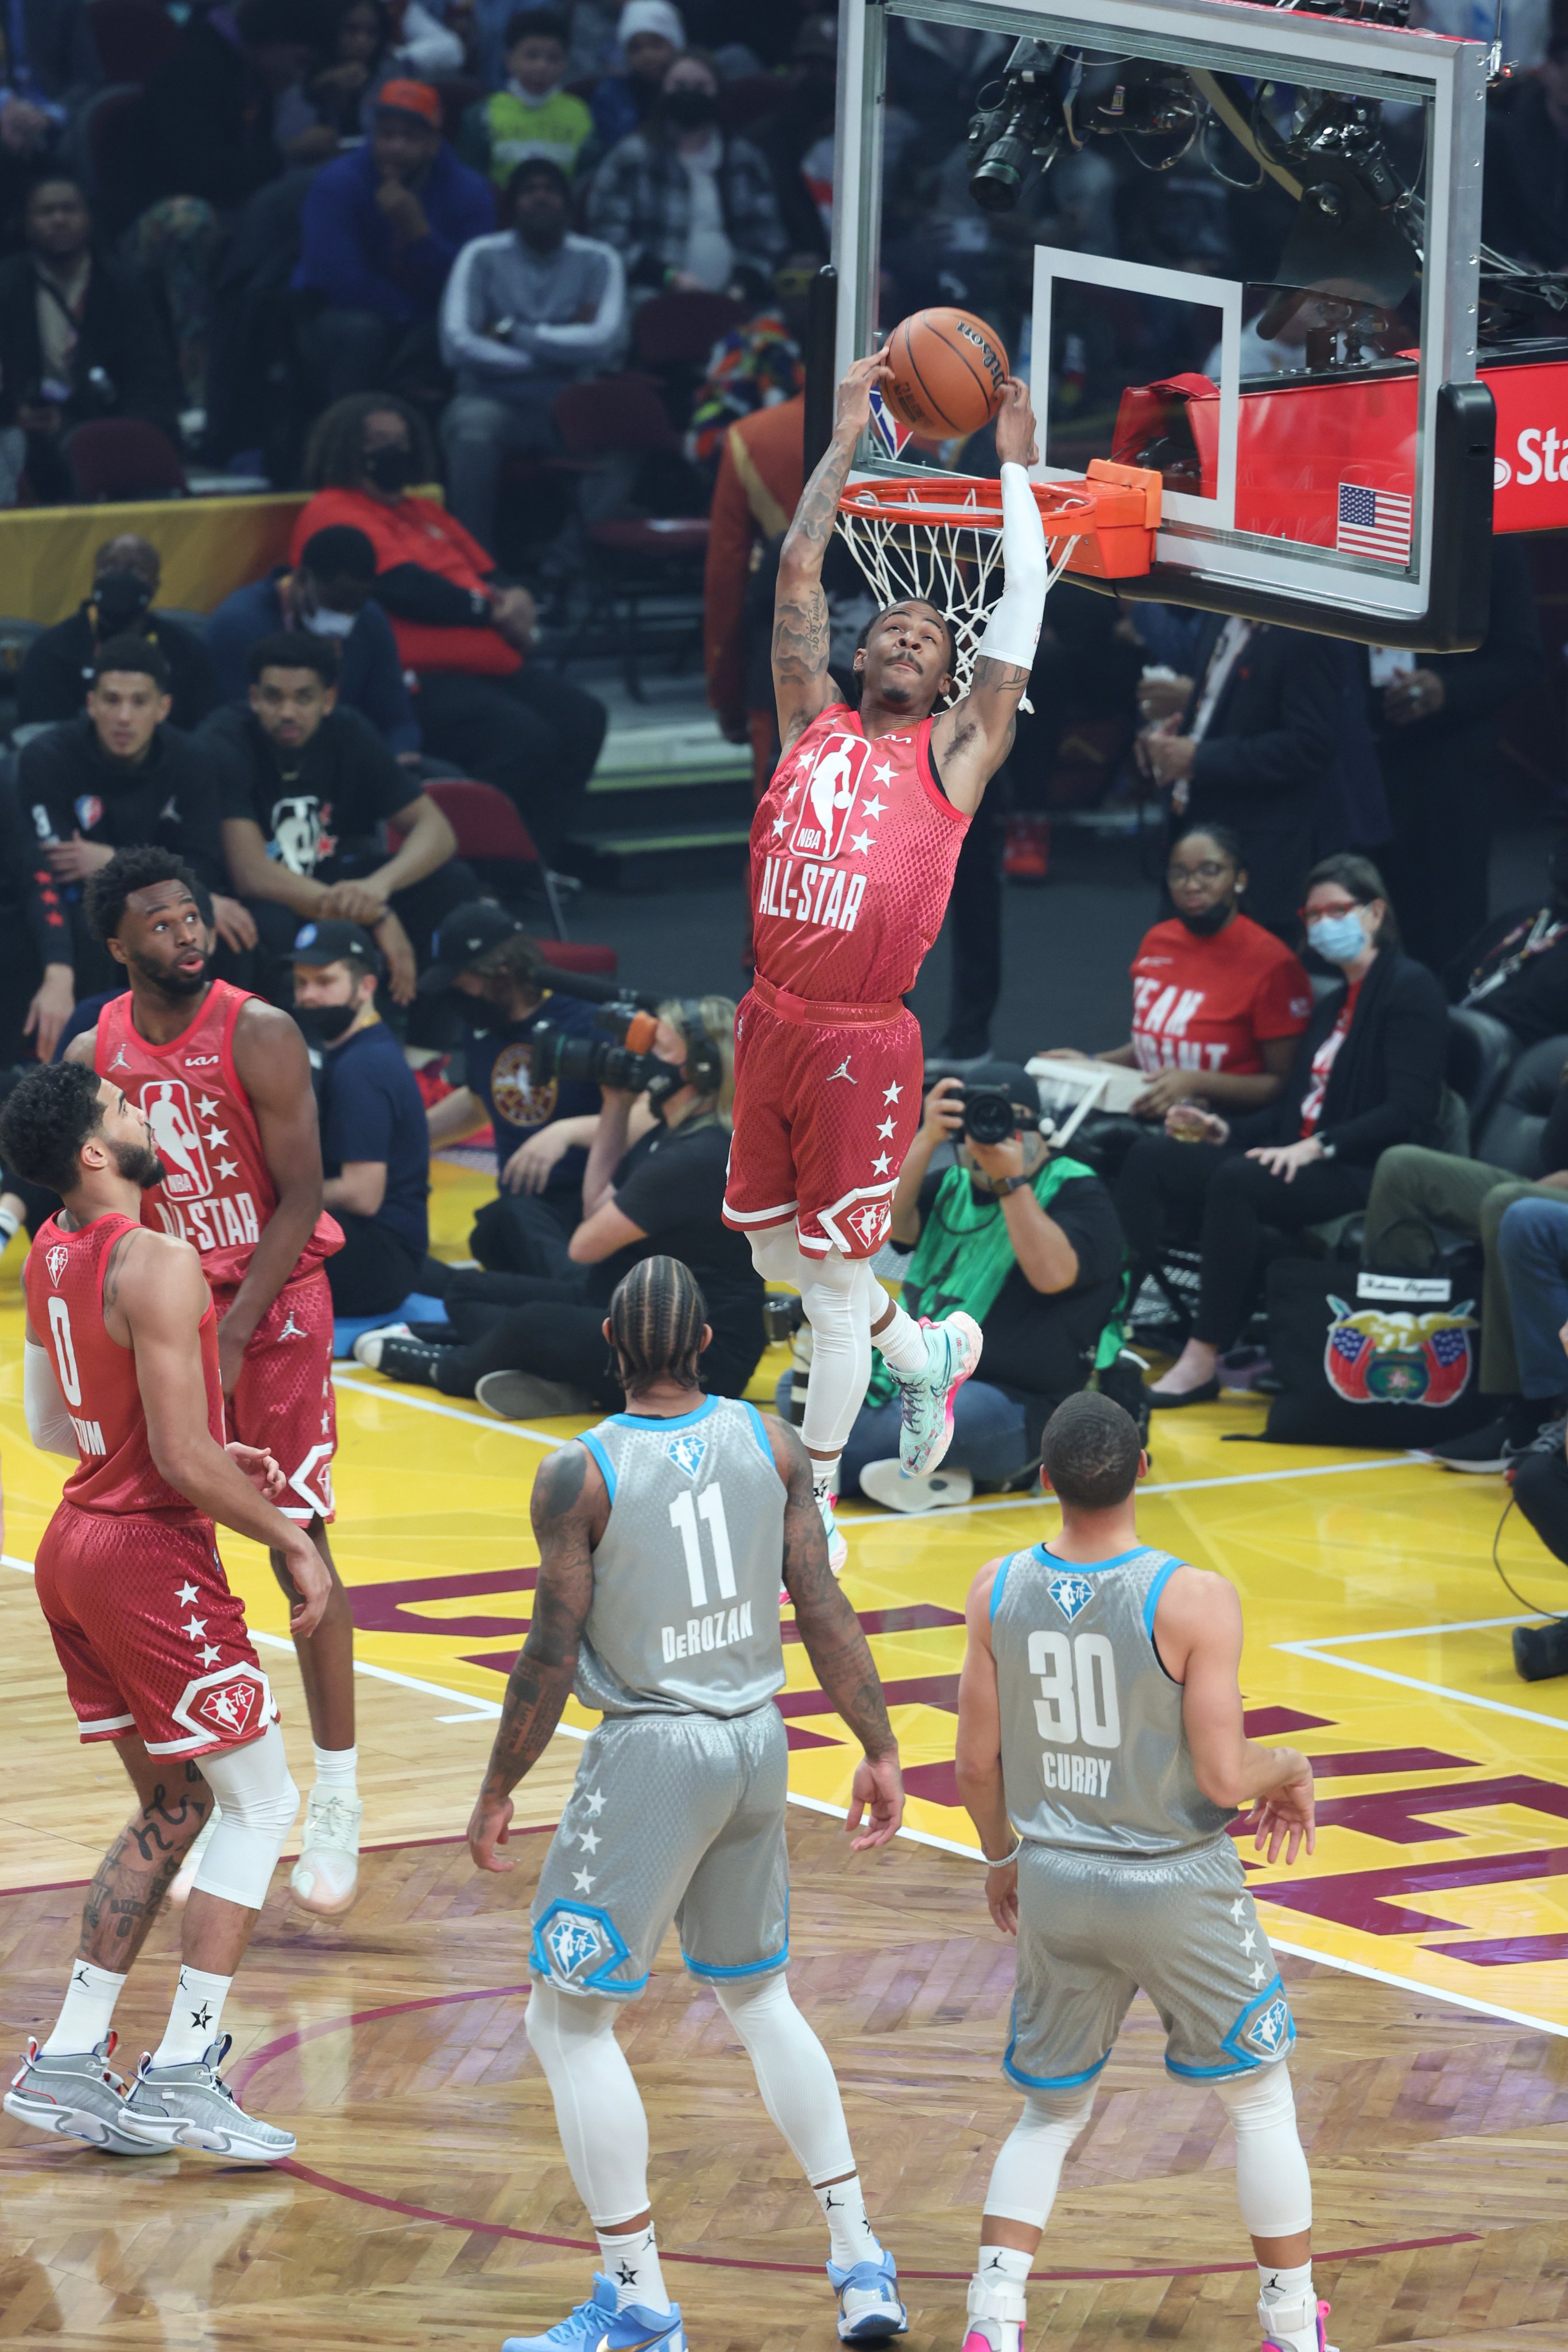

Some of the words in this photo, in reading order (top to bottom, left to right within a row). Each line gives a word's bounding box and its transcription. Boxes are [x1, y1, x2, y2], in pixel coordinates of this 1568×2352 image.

[796, 827, 822, 850] NBA
[758, 856, 868, 932] ALL-STAR
[167, 1173, 194, 1193] NBA
[48, 1296, 82, 1406] 0
[669, 1481, 737, 1607] 11
[1075, 1585, 1085, 1600] 75
[232, 1689, 246, 1707] 75
[1028, 1630, 1121, 1749] 30
[1042, 1751, 1112, 1798] CURRY
